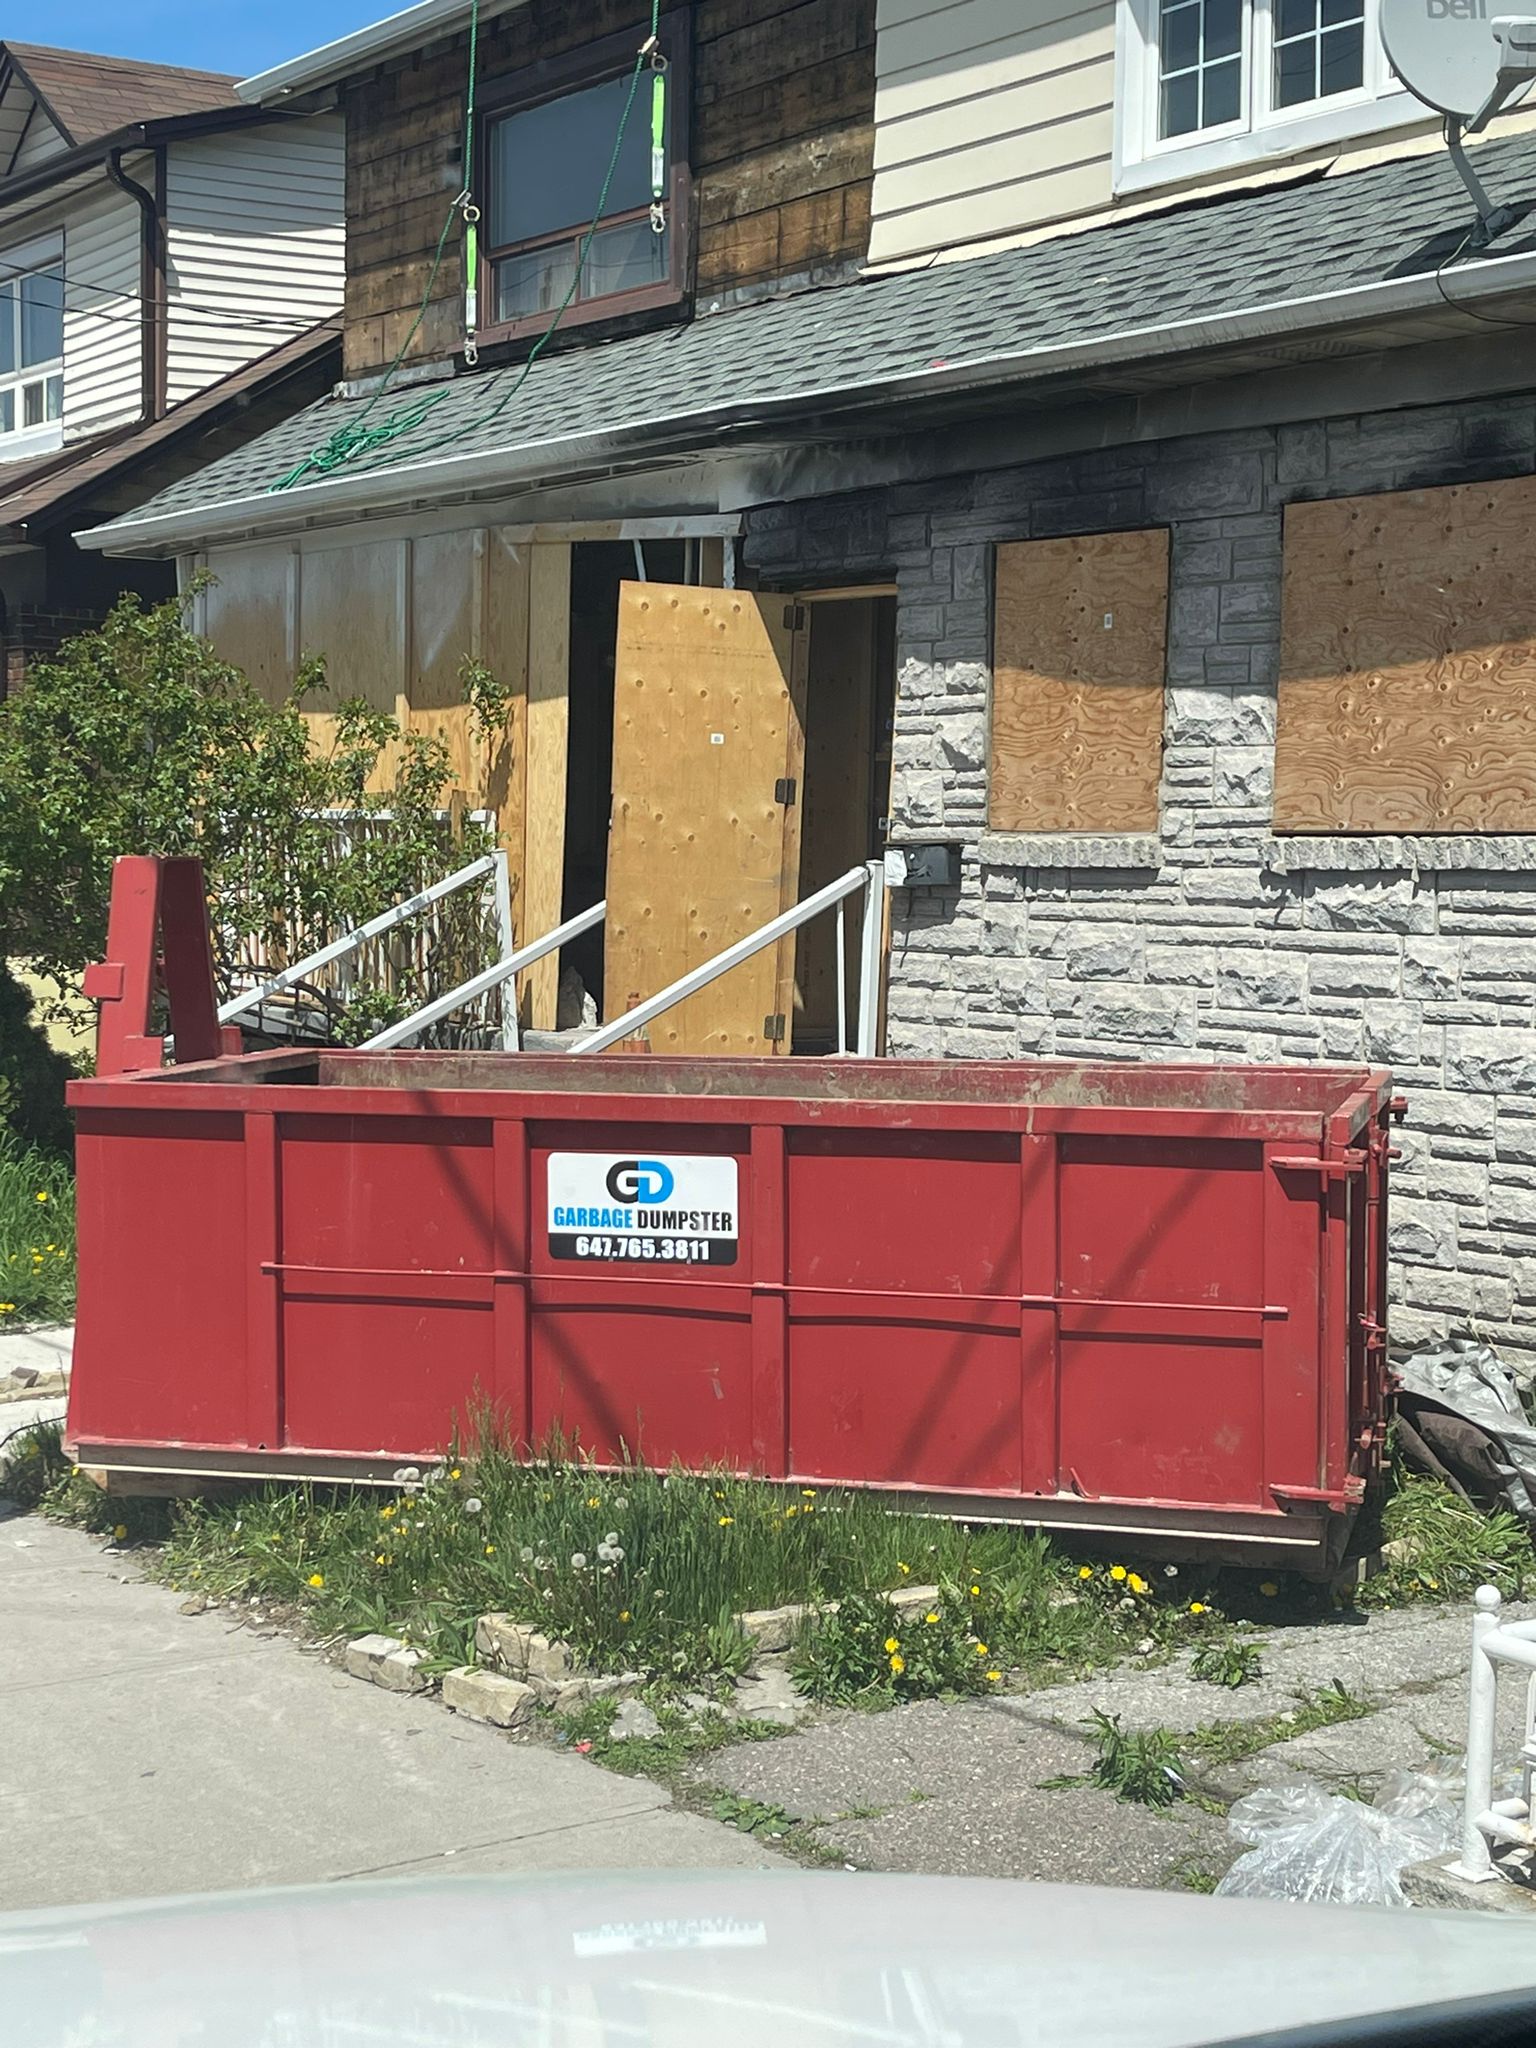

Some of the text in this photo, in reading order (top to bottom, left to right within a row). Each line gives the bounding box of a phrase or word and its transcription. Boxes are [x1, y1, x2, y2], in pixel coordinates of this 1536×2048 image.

[606, 1160, 674, 1204] GD
[553, 1206, 733, 1231] GARBAGE DUMPSTER
[575, 1236, 710, 1260] 647.765.3811
